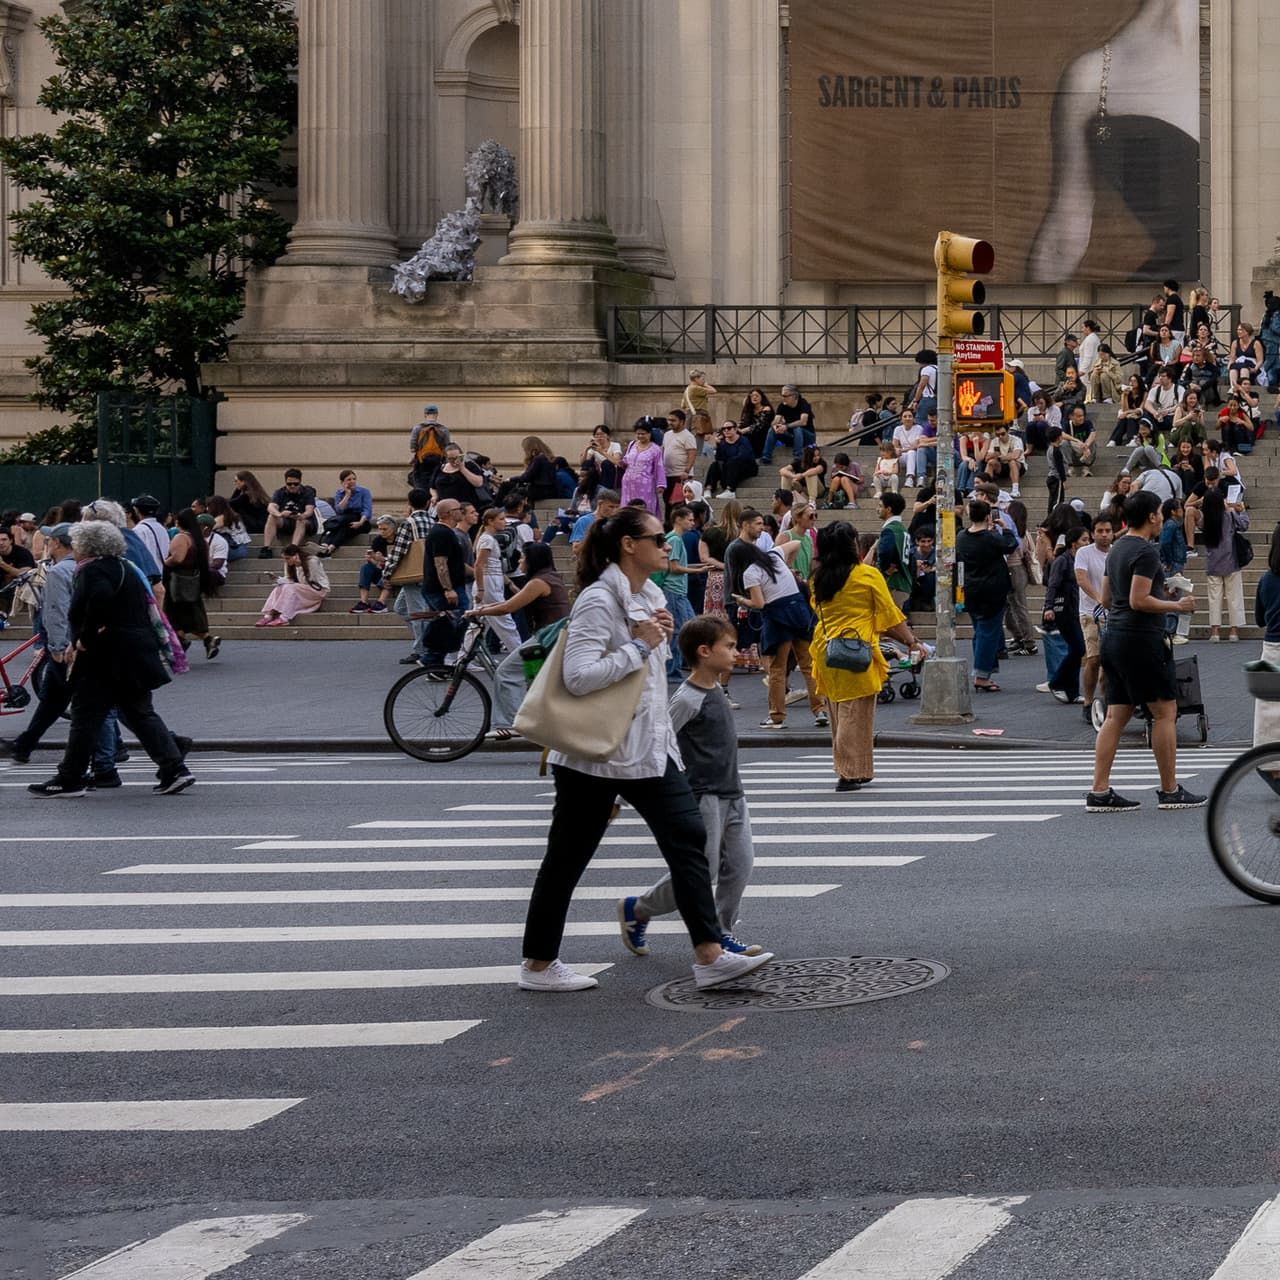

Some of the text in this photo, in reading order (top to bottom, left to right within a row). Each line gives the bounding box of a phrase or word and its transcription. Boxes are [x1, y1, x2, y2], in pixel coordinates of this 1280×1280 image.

[818, 75, 1022, 109] SARGENT & PARIS
[965, 344, 996, 352] STANDING
[957, 352, 982, 360] Anytime
